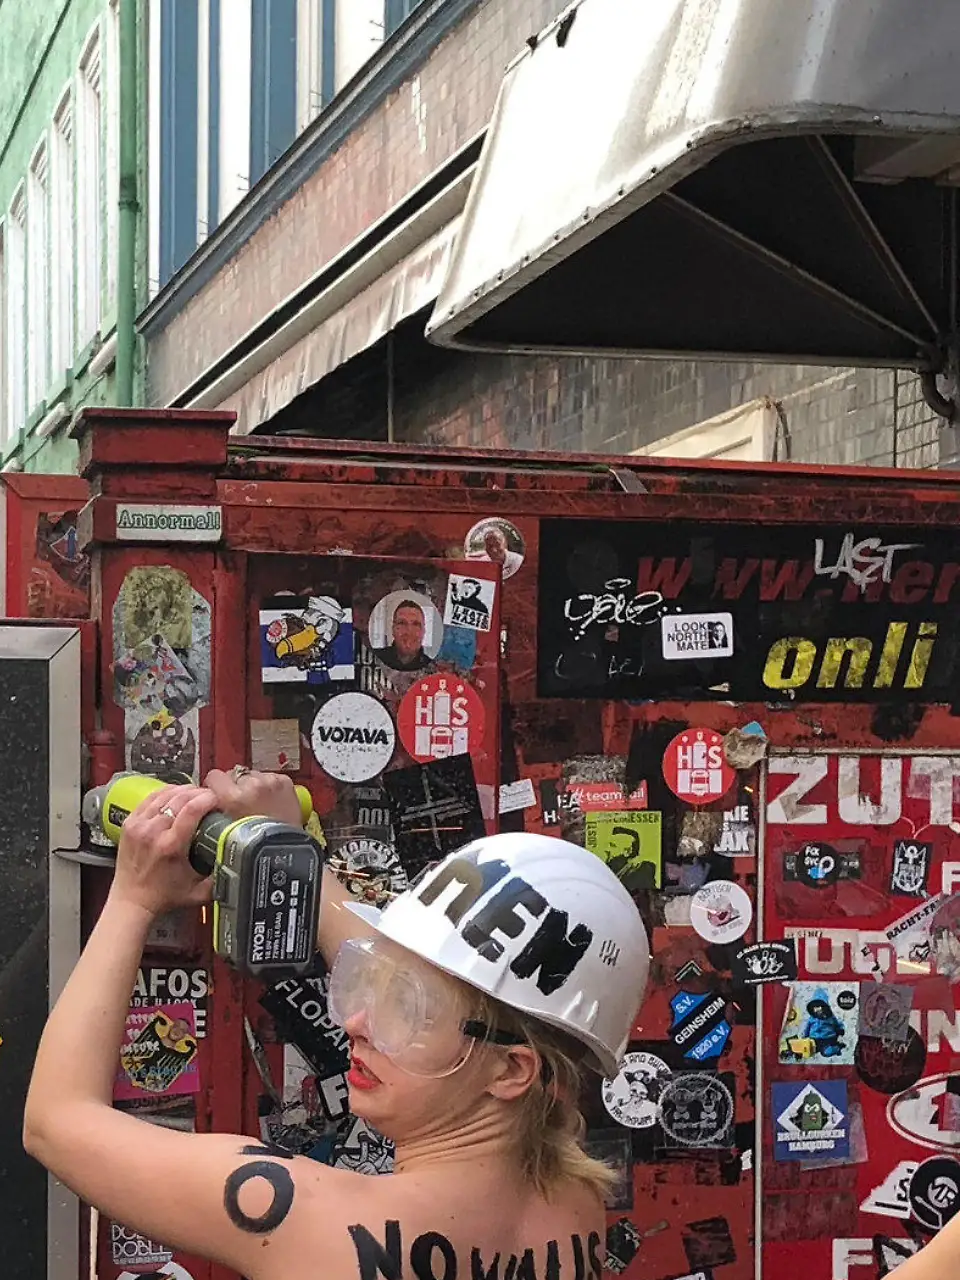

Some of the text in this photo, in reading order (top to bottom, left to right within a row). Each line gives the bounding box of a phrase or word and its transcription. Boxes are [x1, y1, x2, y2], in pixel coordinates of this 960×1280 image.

[117, 509, 221, 530] Annormal!
[667, 632, 708, 642] NORTH
[674, 621, 707, 632] LOOK
[677, 641, 708, 651] MATE
[762, 622, 939, 690] onli
[317, 725, 390, 746] VOTAVA
[252, 919, 266, 962] RYOBI
[675, 997, 726, 1045] GEINSHEIM
